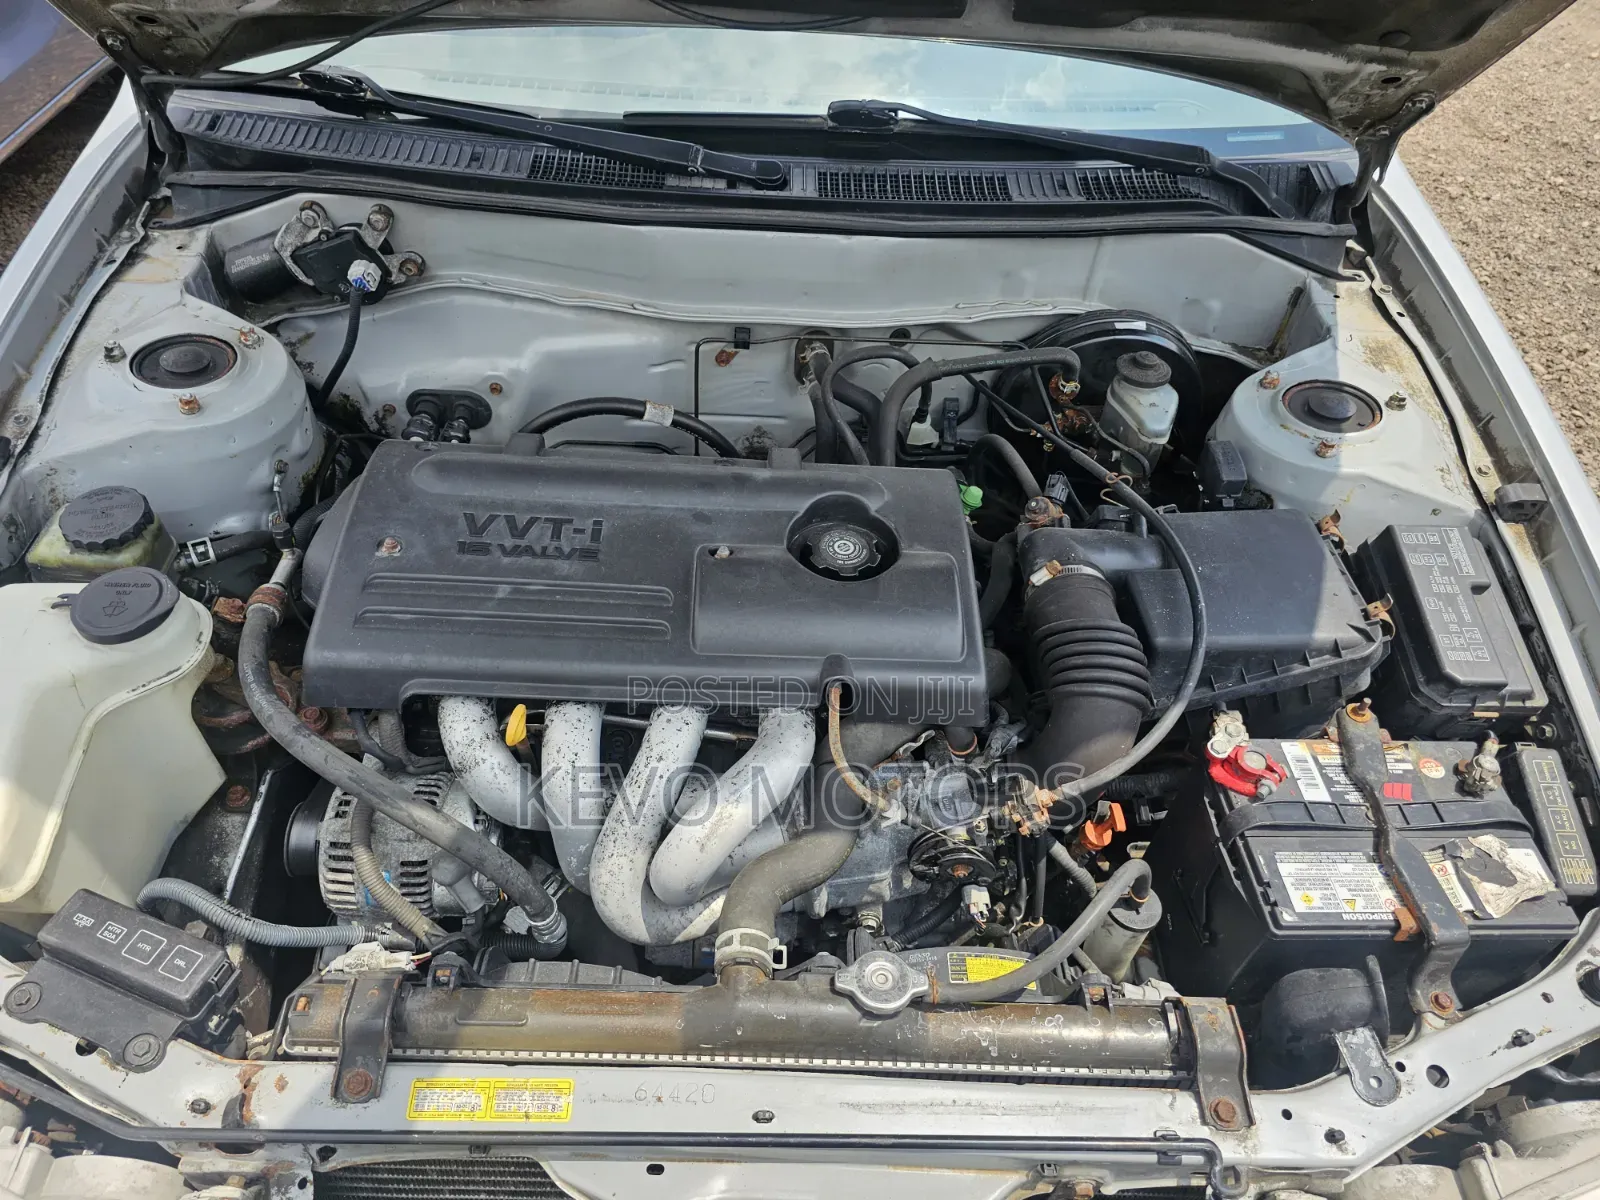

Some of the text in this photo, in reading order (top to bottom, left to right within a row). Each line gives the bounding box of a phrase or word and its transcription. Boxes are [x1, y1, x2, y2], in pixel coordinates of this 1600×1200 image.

[456, 540, 600, 562] 16 VALVE
[137, 942, 152, 952] HTR
[174, 958, 187, 969] DRL
[634, 1081, 716, 1104] 64420
